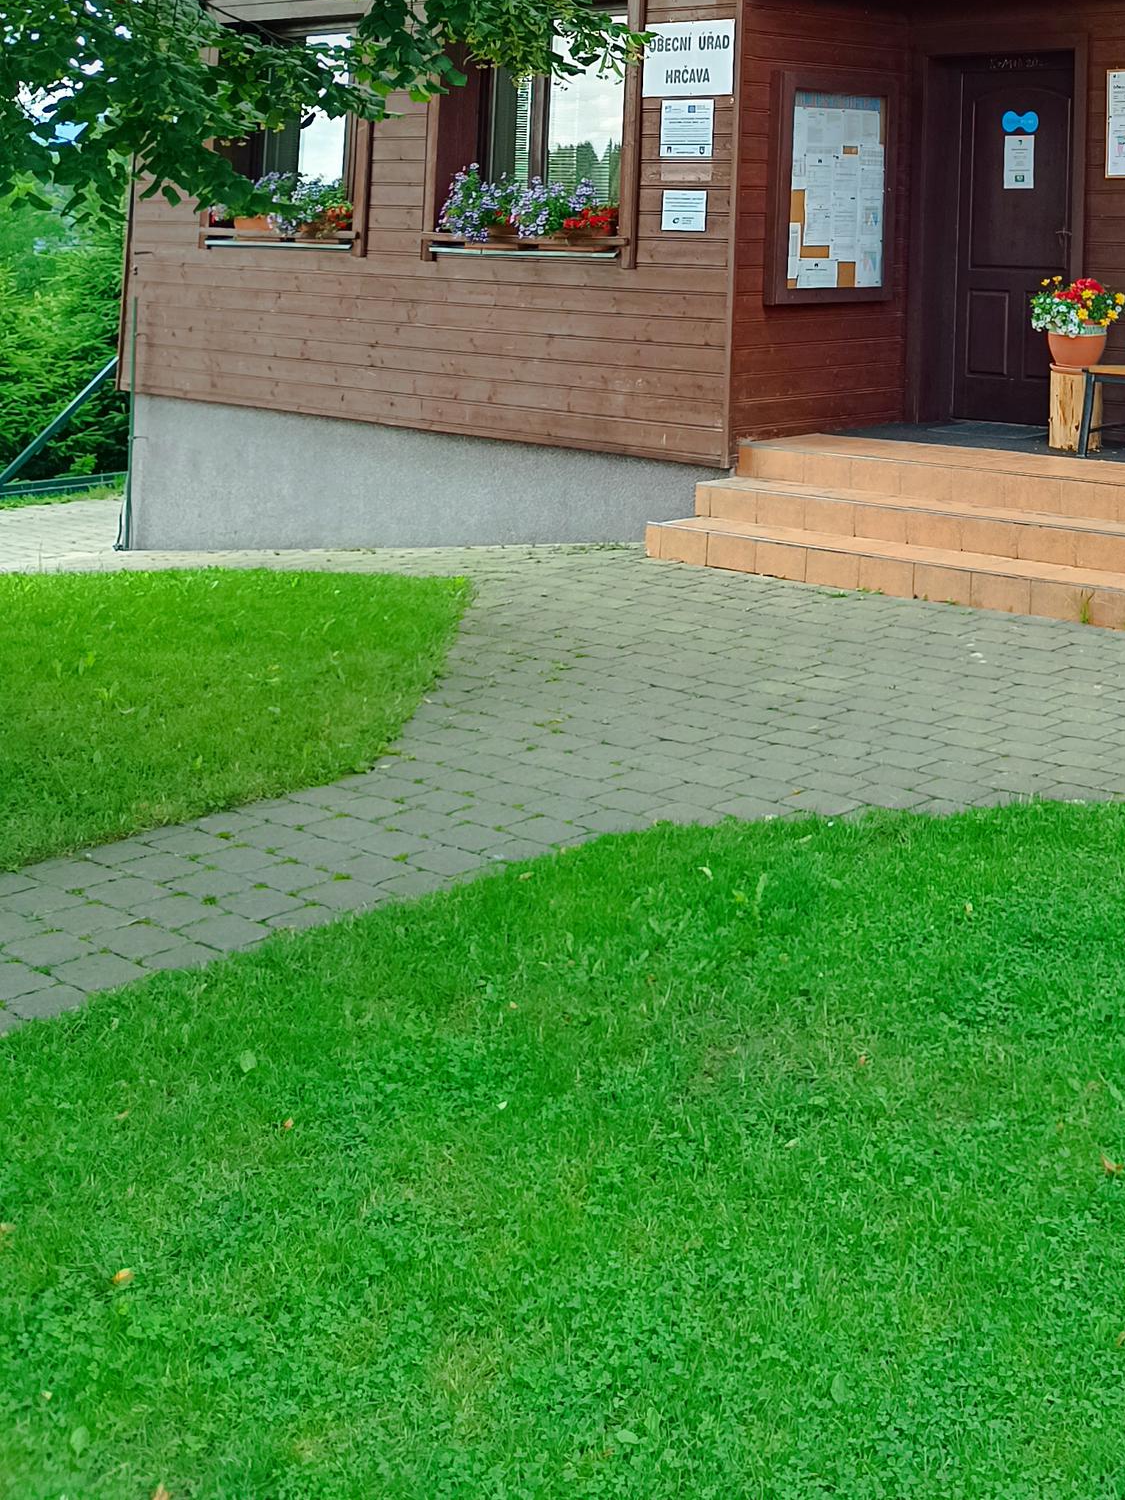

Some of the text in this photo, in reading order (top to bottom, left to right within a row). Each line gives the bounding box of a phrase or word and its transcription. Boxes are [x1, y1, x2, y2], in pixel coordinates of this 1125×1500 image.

[649, 31, 730, 53] OBECNÍ ÚŘAD
[665, 64, 710, 84] HRČAVA
